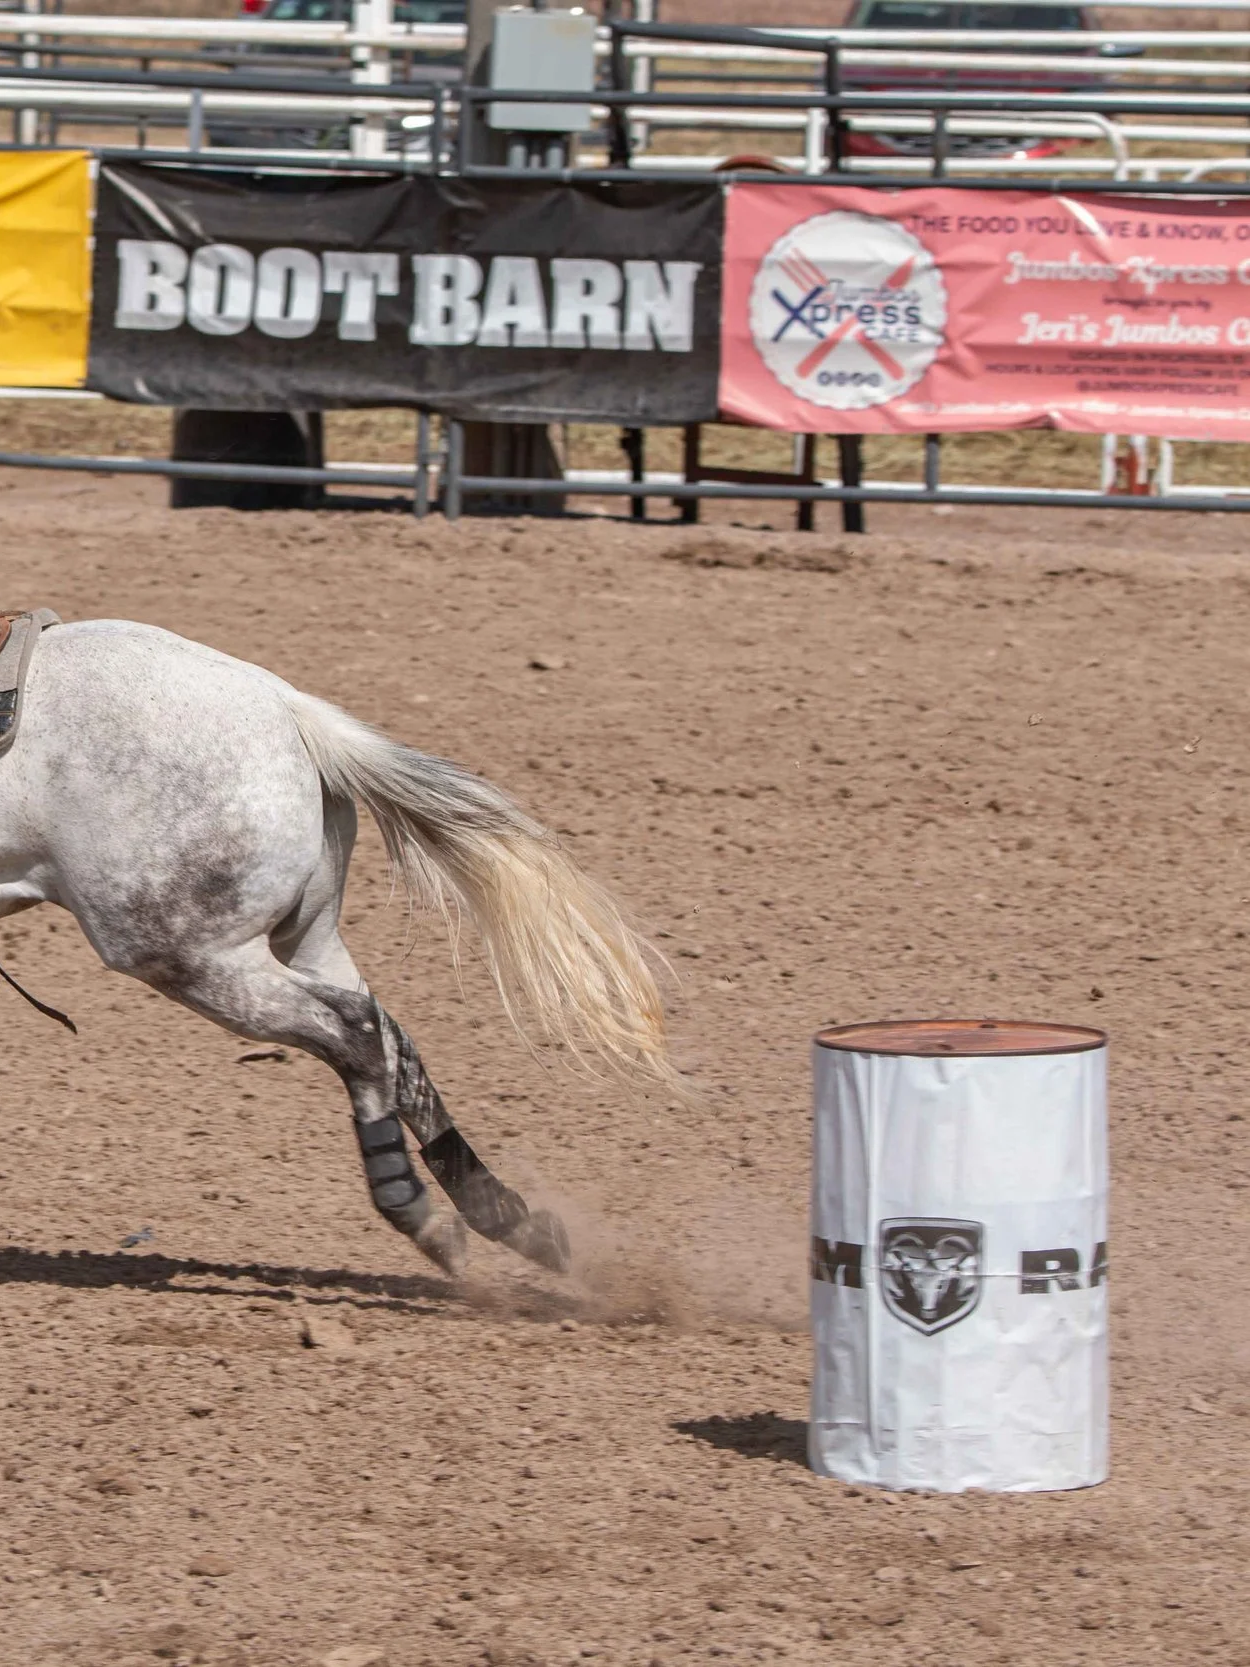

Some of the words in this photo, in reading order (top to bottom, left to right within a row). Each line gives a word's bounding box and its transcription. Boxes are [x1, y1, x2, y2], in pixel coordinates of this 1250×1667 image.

[911, 215, 952, 233] THE
[957, 216, 1020, 234] FOOD
[1025, 217, 1069, 235] YOU
[1137, 221, 1151, 239] &
[115, 239, 399, 342] BOOT
[409, 253, 703, 353] BARN
[1004, 251, 1120, 285] Jumbos
[1126, 256, 1230, 296] Xpress
[771, 285, 921, 343] Xpress
[1015, 311, 1100, 345] Jeri's
[1102, 313, 1220, 347] Jumbos
